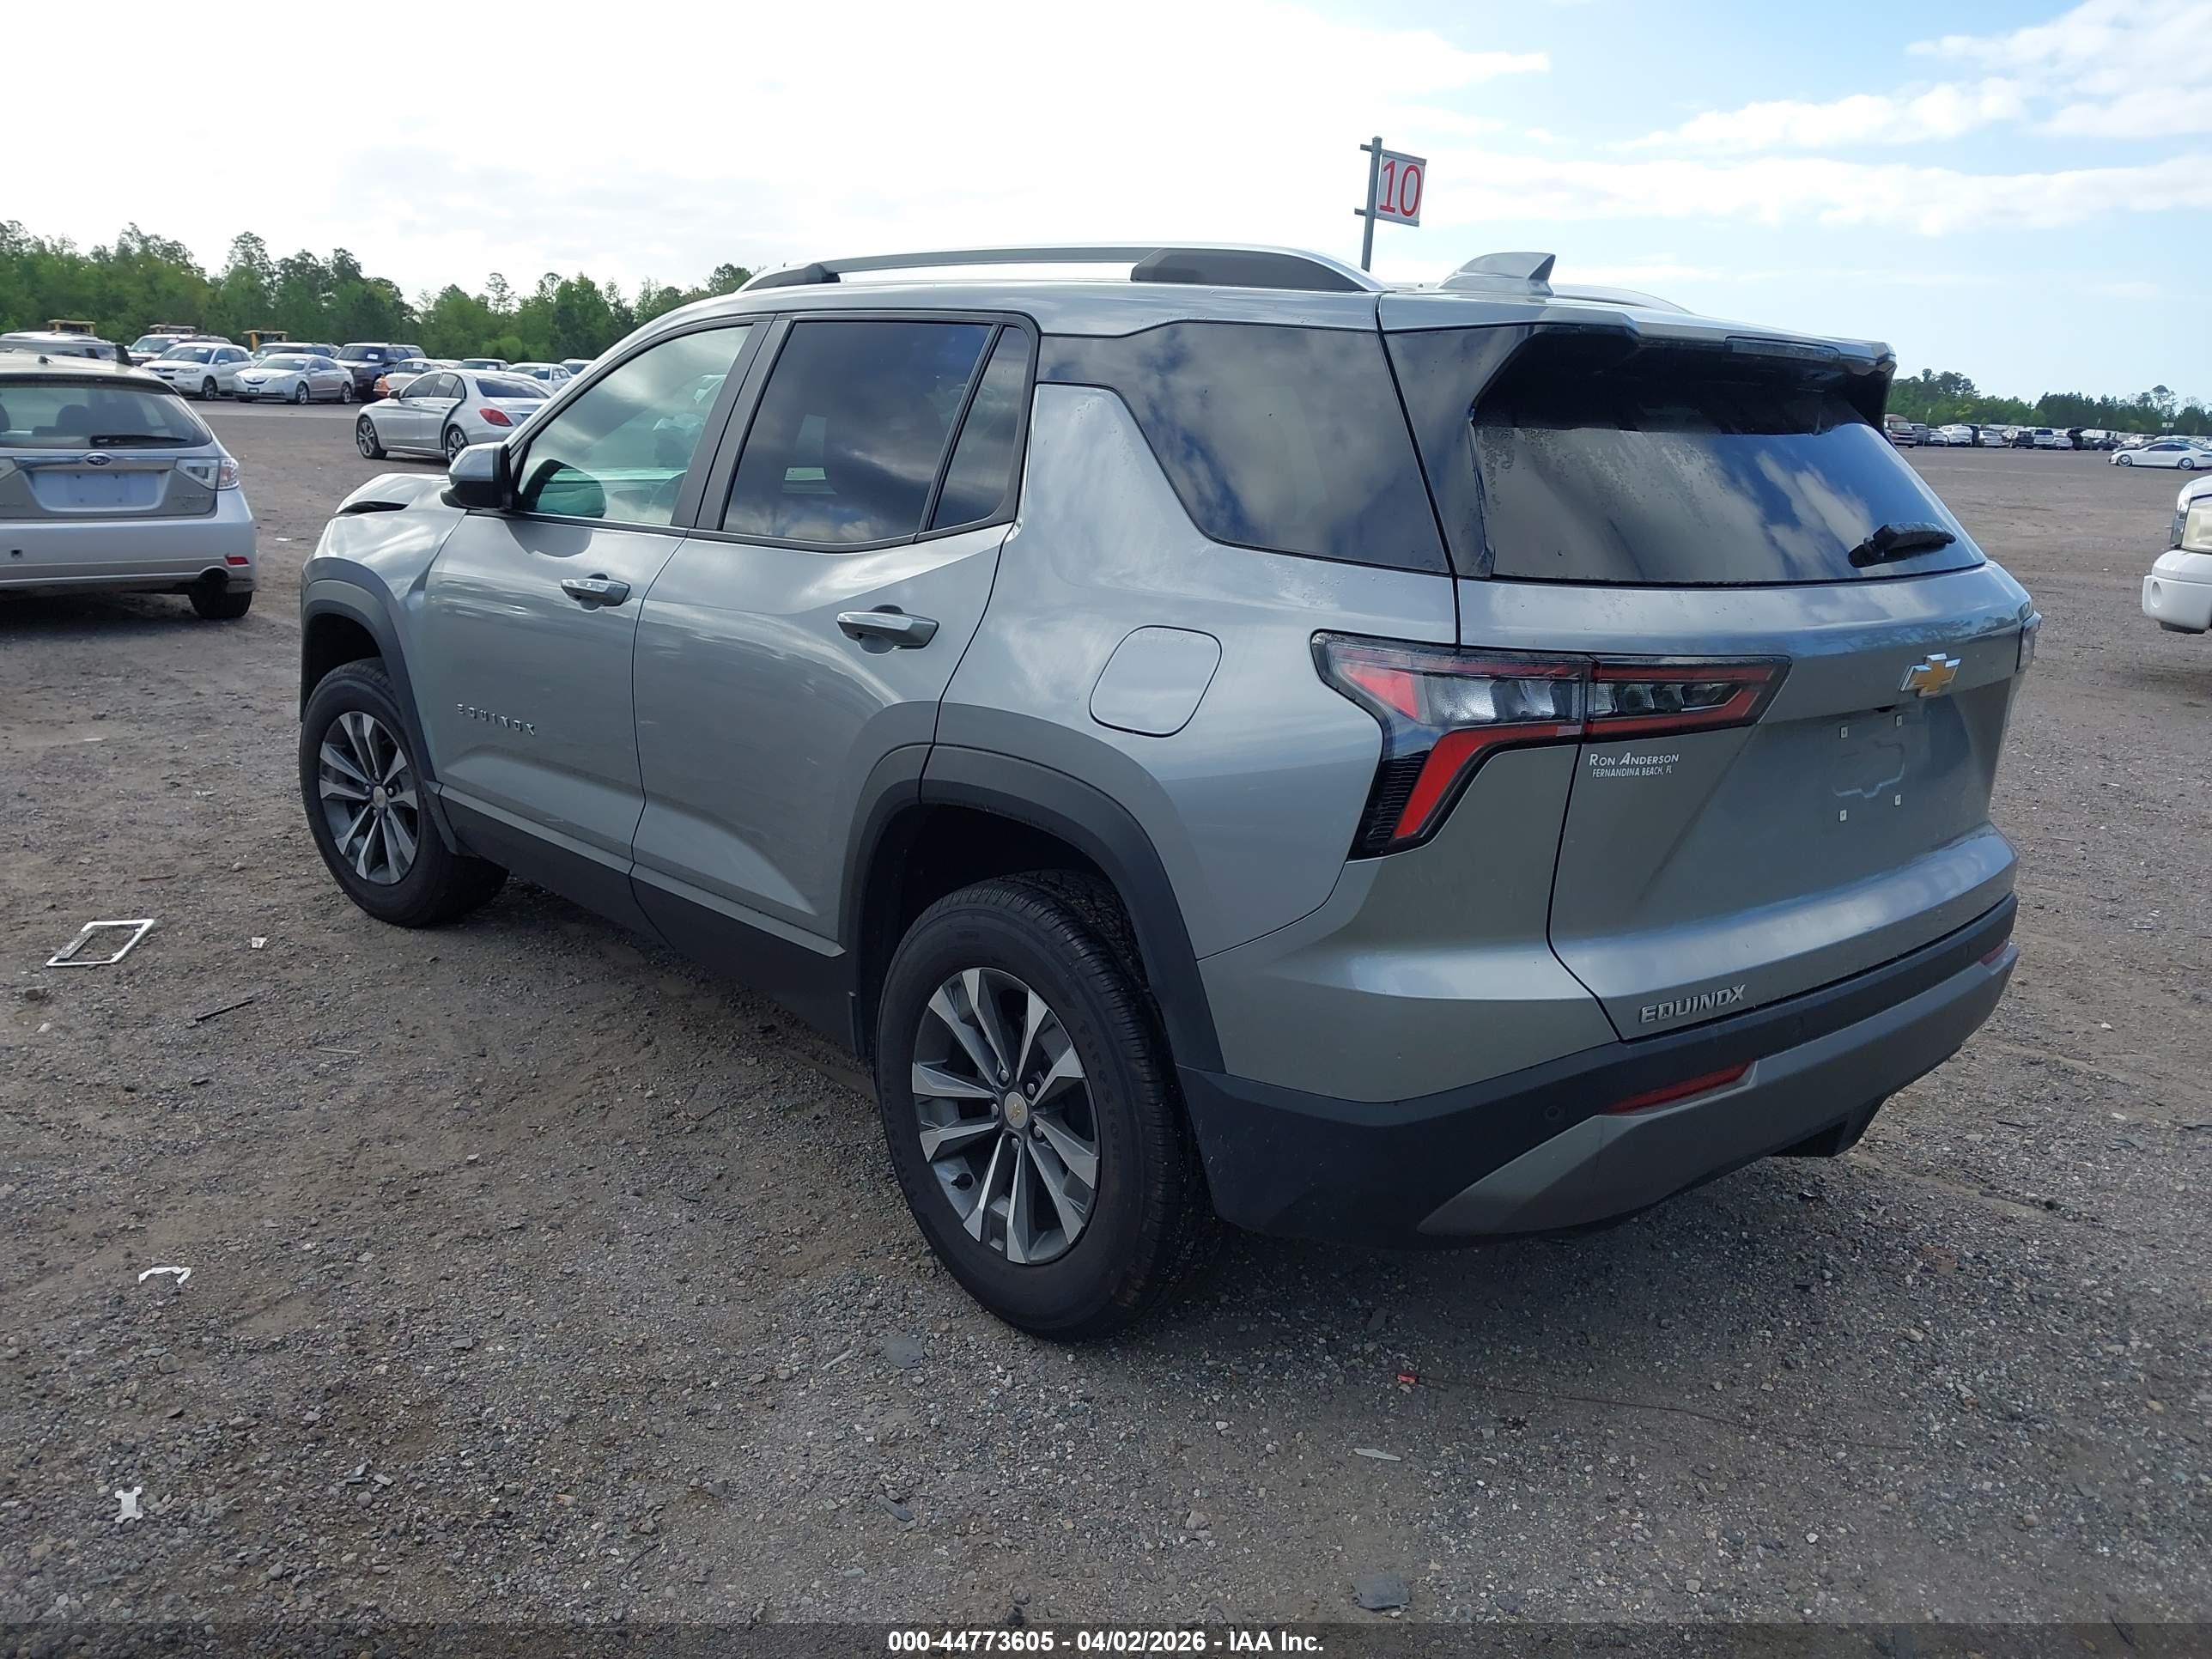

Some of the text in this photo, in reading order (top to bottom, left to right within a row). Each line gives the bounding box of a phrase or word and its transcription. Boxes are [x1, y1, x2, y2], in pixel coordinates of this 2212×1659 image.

[1379, 160, 1422, 217] 10
[456, 702, 535, 736] EQUINOX
[1592, 767, 1640, 777] FERNANDINA
[1665, 764, 1673, 775] FL
[1639, 983, 1746, 1024] EQUINOX
